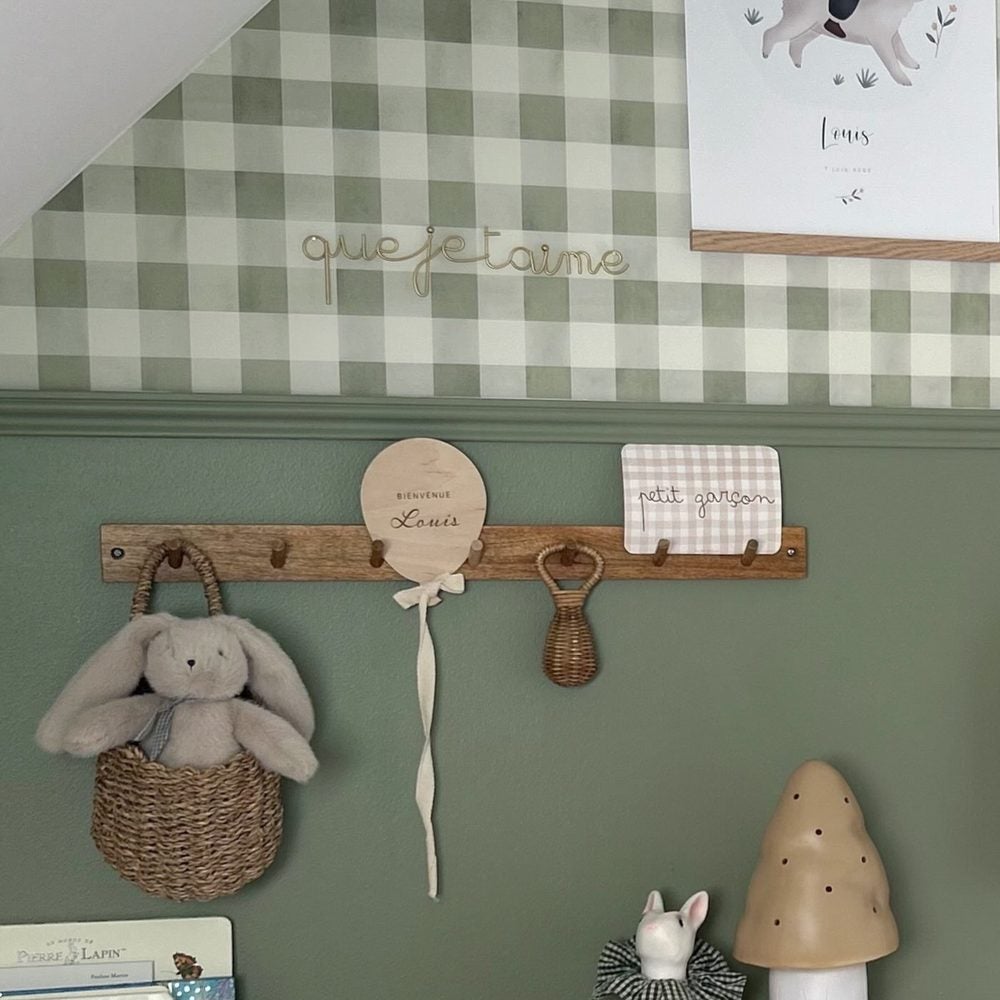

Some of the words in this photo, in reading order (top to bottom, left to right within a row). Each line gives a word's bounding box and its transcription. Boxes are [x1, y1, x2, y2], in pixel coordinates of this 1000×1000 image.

[821, 116, 874, 150] Louis
[396, 490, 452, 500] BIENVENUE
[390, 508, 461, 529] Louis
[638, 485, 684, 532] petit
[695, 490, 775, 518] garçon
[81, 947, 121, 961] LAPIN
